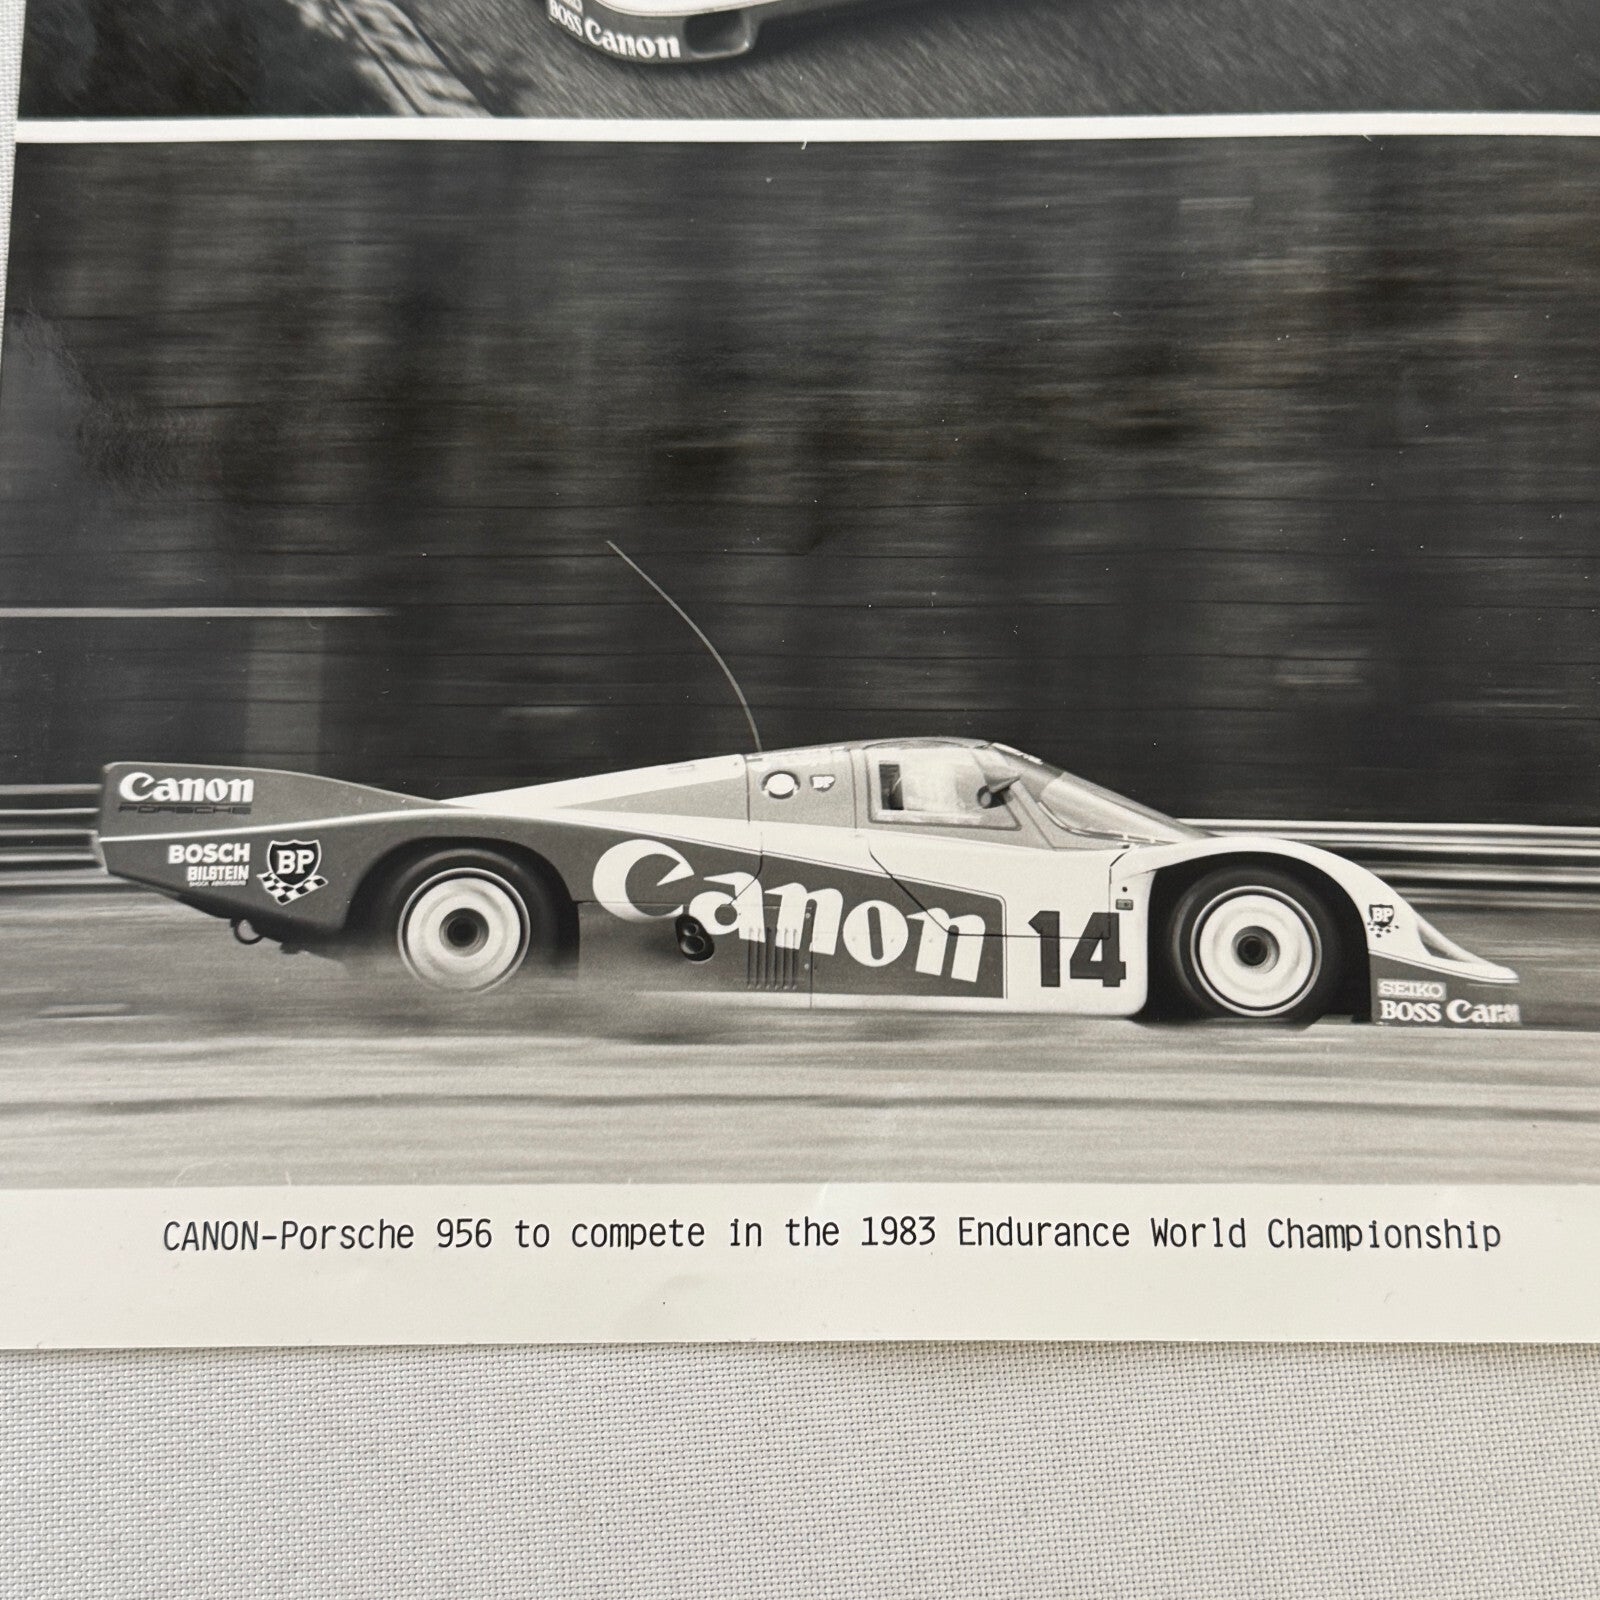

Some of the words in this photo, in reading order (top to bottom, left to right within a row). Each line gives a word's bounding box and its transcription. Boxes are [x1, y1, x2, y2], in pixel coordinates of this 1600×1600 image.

[549, 0, 583, 37] BOSS
[584, 17, 681, 59] Canon
[118, 771, 254, 803] Canon
[168, 843, 251, 864] BOSCH
[277, 850, 315, 875] BP
[187, 865, 249, 882] BILSTEIN
[592, 839, 987, 983] Canon
[1372, 907, 1394, 922] BP
[1028, 911, 1127, 988] 14
[1380, 982, 1444, 997] SEIKO
[1379, 1000, 1442, 1023] BOSS
[164, 1217, 414, 1251] CANON-Porsche
[437, 1217, 492, 1249] 956
[515, 1218, 550, 1248] to
[572, 1217, 705, 1252] compete
[731, 1217, 762, 1247] in
[786, 1215, 840, 1247] the
[862, 1215, 936, 1246] 1983
[959, 1215, 1130, 1247] Endurance
[1151, 1216, 1246, 1249] World
[1268, 1216, 1502, 1252] Championship
